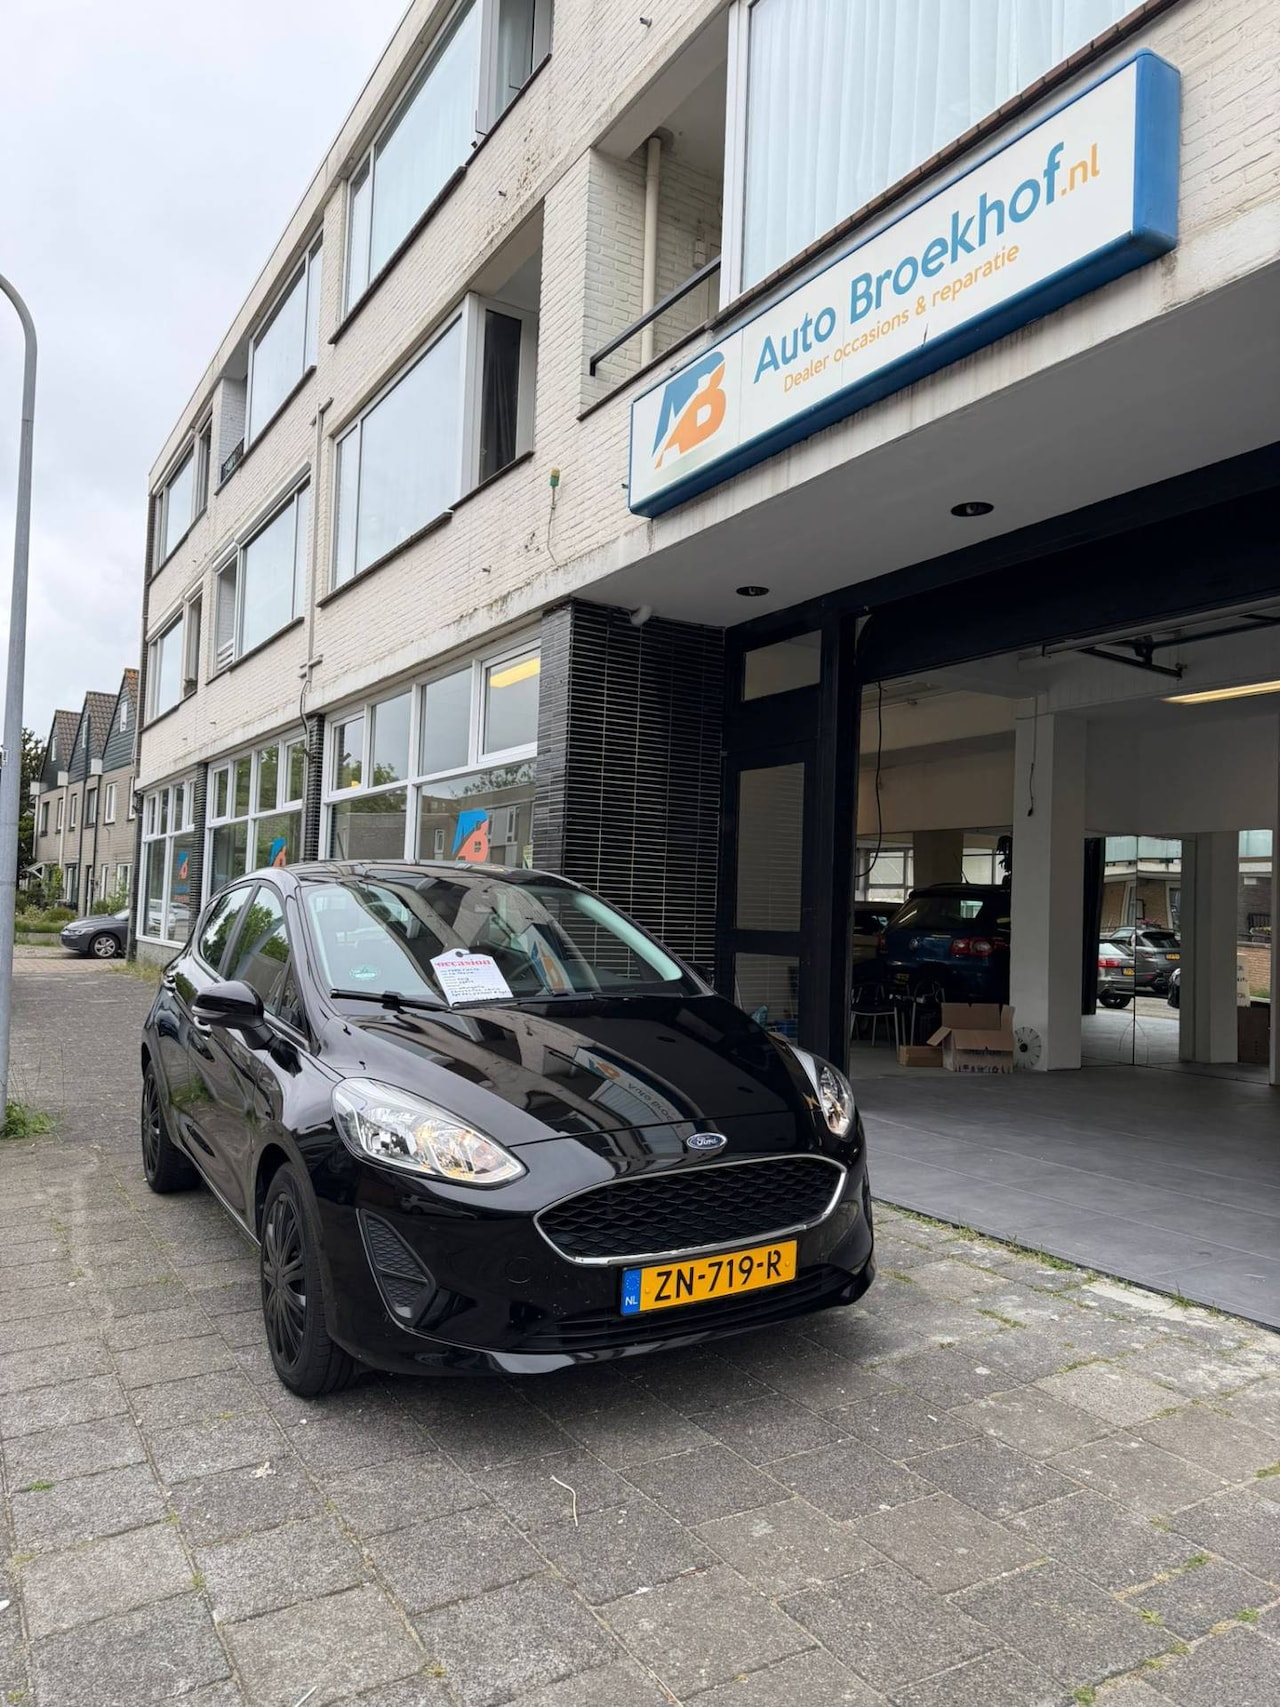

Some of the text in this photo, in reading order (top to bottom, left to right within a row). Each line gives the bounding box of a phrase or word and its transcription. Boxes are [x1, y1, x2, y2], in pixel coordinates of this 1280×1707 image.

[753, 141, 1100, 385] Auto Broekhof.nl
[783, 244, 1021, 394] Dealer occasions & reparatie
[624, 1294, 639, 1307] NL
[654, 1249, 782, 1302] ZN-719-R
